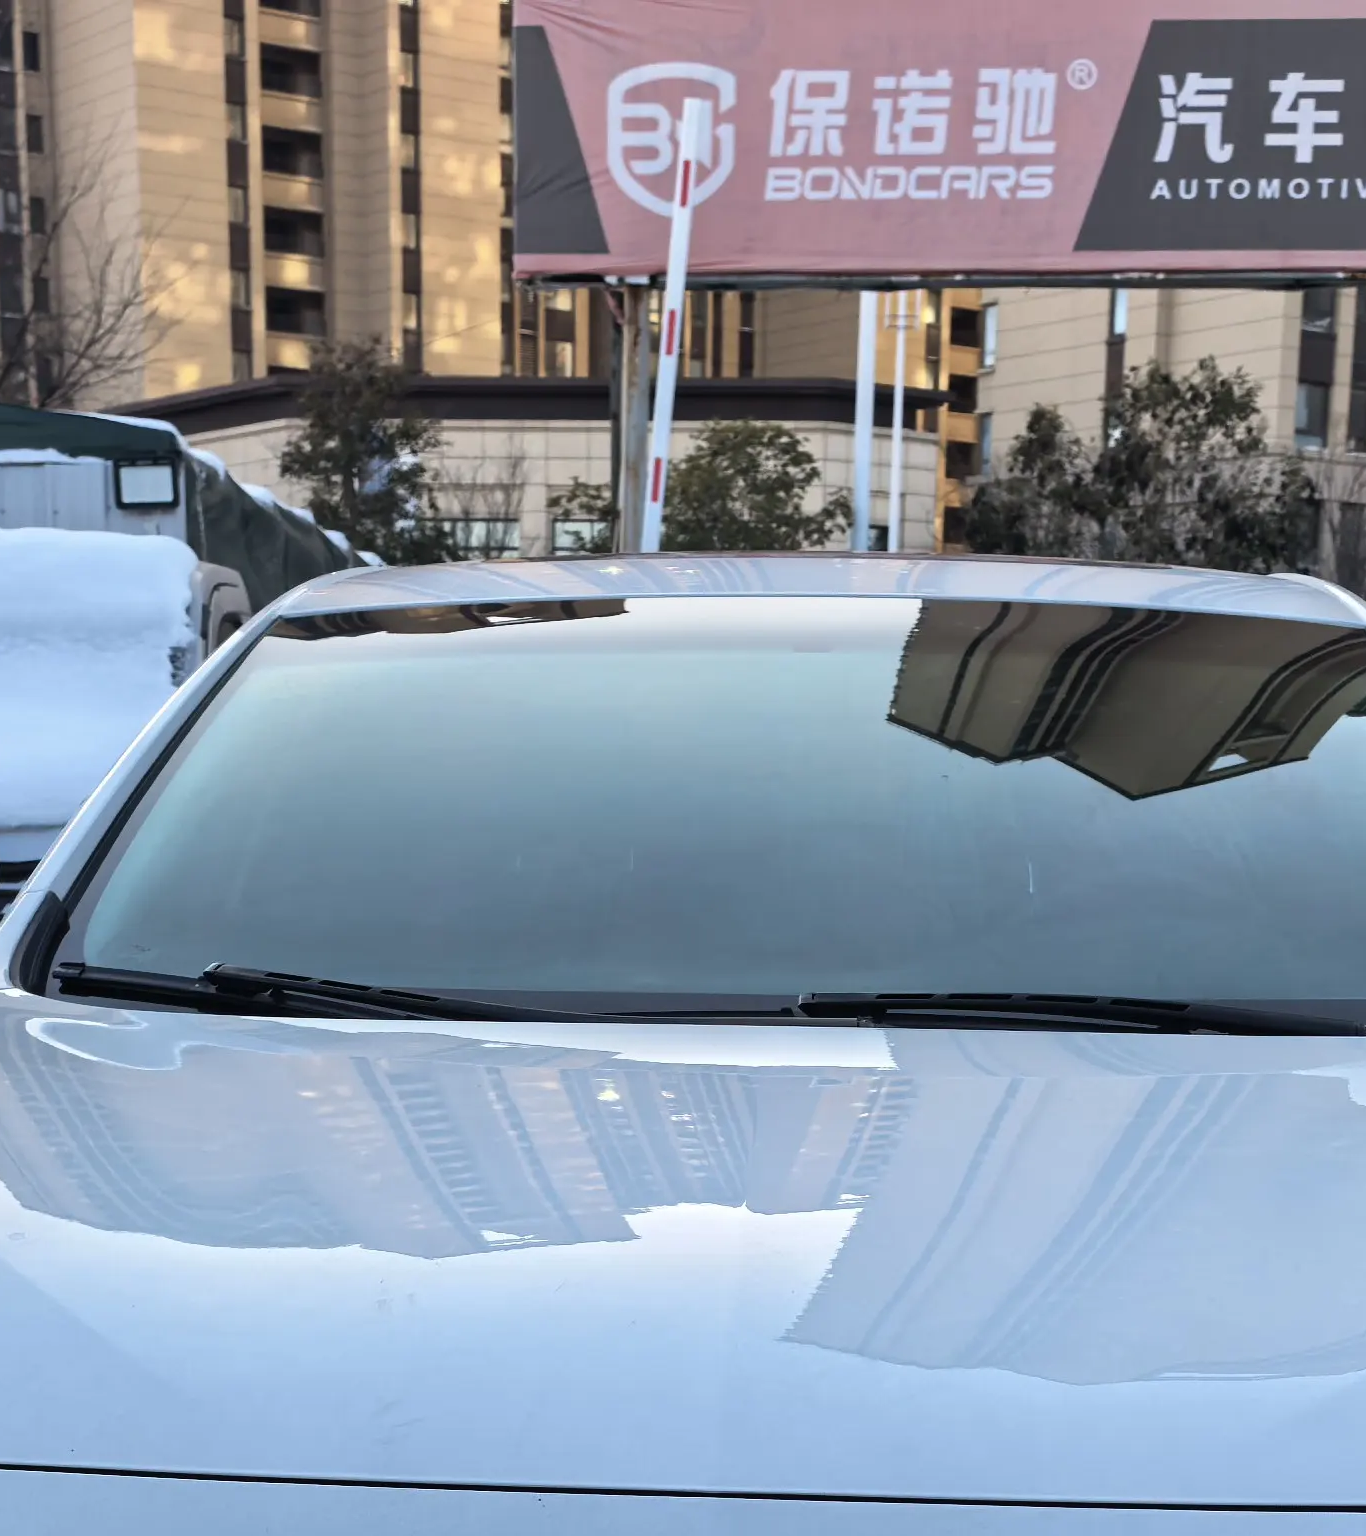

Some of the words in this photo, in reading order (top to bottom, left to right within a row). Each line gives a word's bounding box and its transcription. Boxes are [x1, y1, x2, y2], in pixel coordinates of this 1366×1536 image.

[769, 67, 1057, 157] 保诺驰
[764, 166, 1055, 201] BONDCARS
